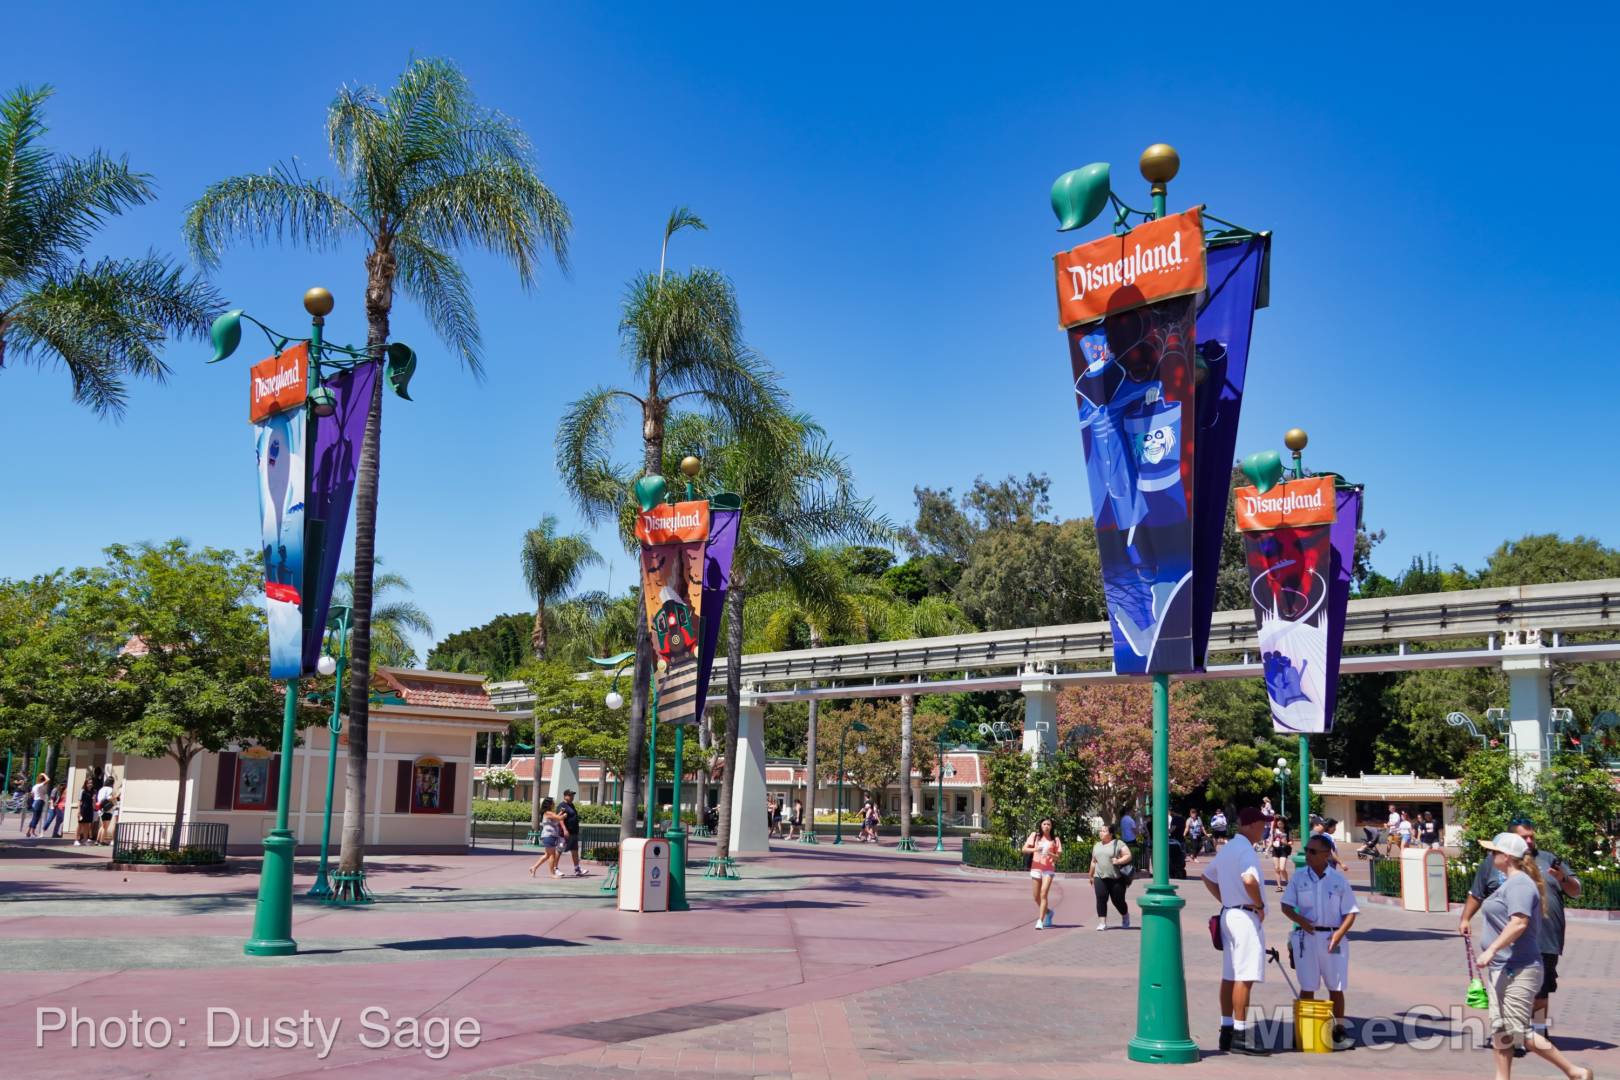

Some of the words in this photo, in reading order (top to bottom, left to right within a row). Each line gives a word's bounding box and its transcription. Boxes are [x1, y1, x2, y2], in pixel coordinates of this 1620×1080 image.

[1067, 231, 1183, 301] Disneyland
[255, 358, 300, 403] Disneyland
[1243, 487, 1322, 517] Disneyland
[643, 510, 701, 533] Disneyland
